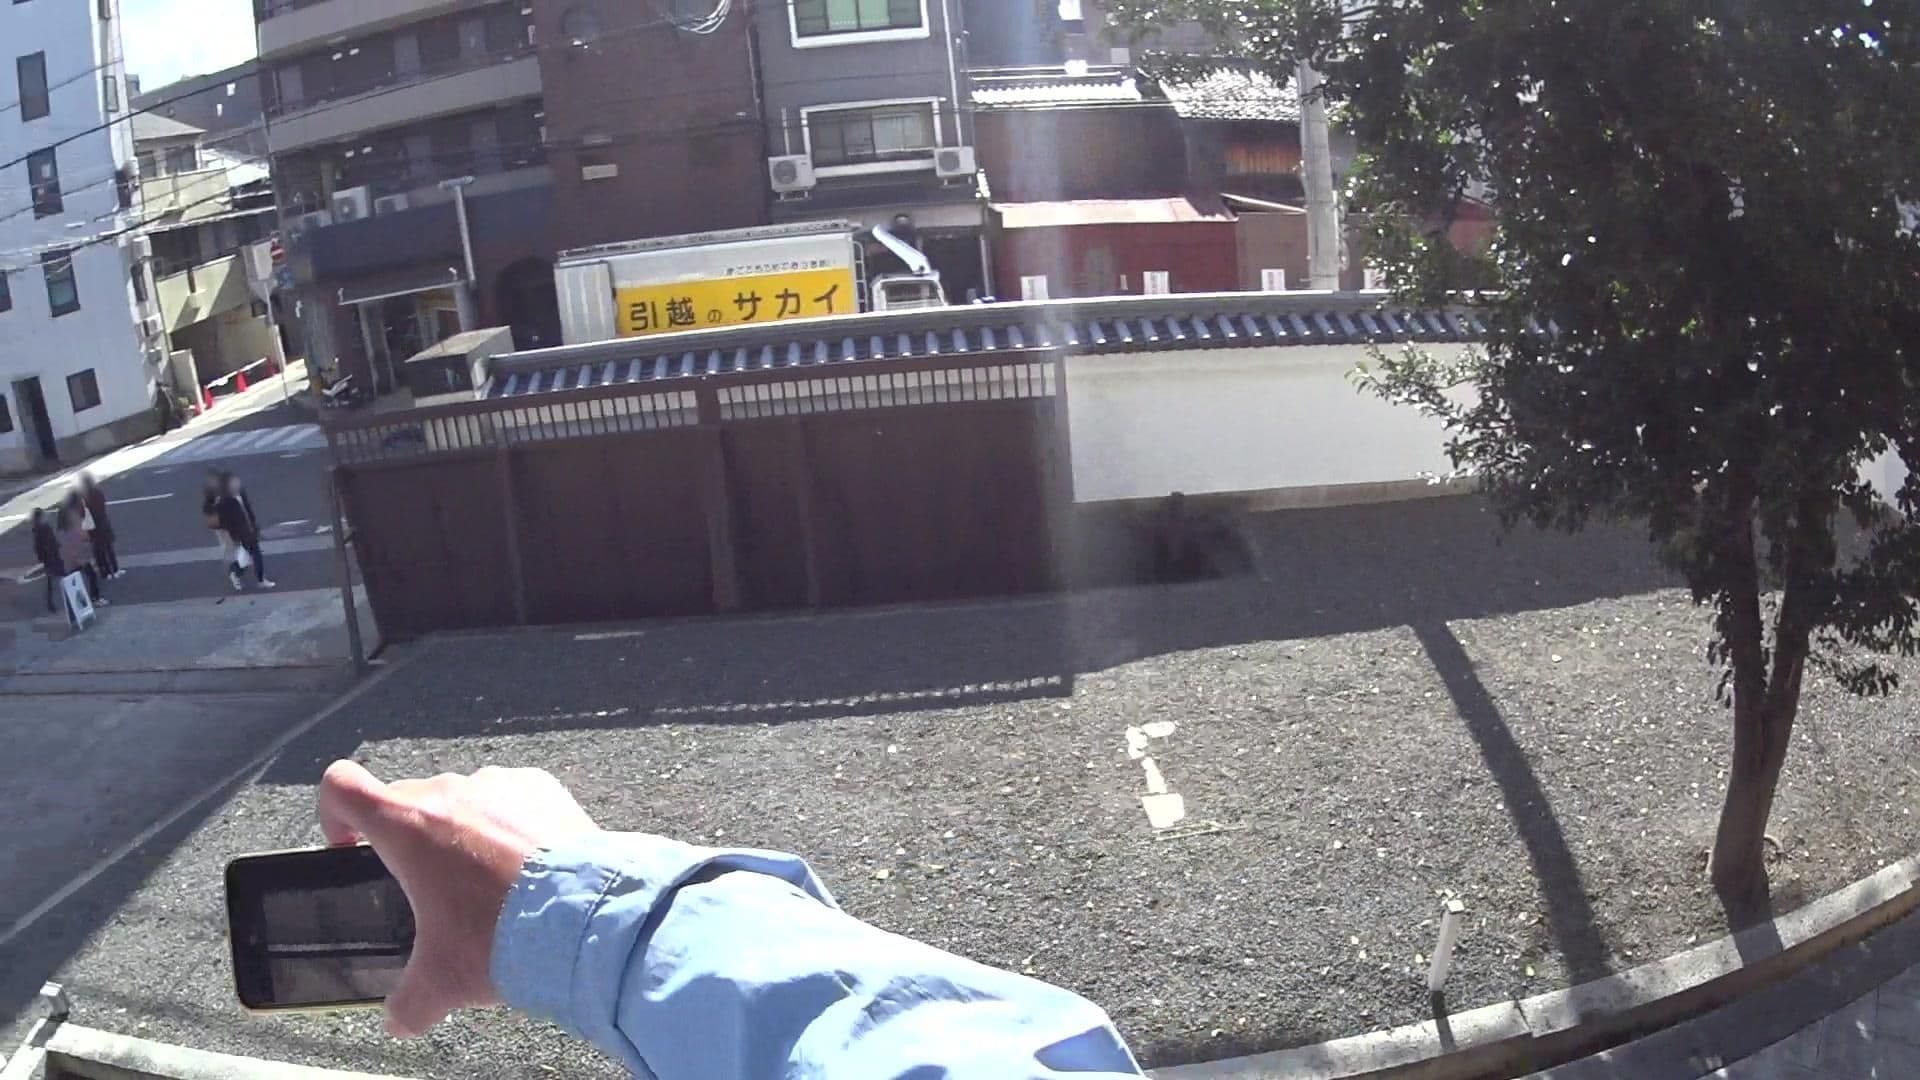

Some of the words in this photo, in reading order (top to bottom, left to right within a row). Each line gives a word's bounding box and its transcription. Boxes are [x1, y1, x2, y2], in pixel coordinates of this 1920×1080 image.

[629, 284, 839, 331] 引越のサカイ
